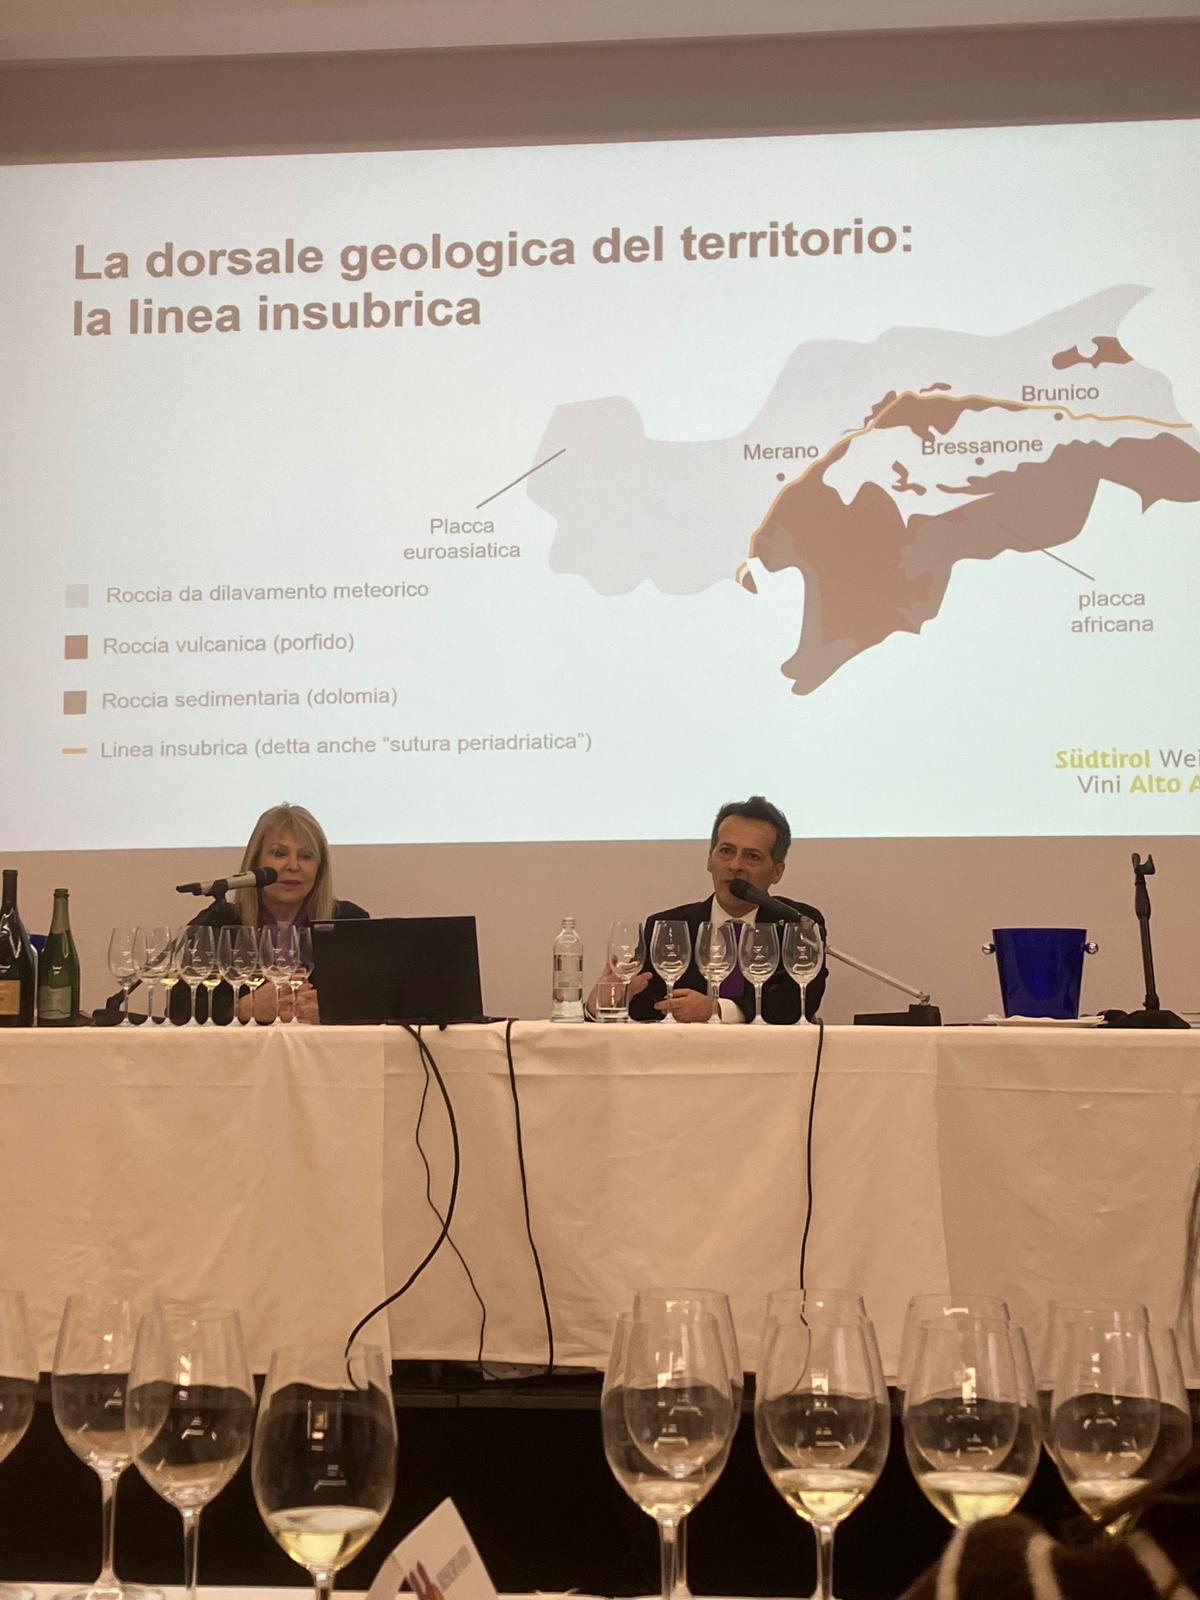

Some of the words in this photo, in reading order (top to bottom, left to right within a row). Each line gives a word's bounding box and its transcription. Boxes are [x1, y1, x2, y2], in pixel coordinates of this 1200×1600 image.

[75, 245, 128, 280] La
[146, 238, 323, 278] dorsale
[340, 231, 575, 281] geologica
[593, 226, 663, 264] del
[680, 218, 911, 261] territorio:
[74, 301, 111, 336] la
[130, 298, 240, 335] linea
[259, 291, 480, 331] insubrica
[1021, 384, 1099, 402] Brunico
[743, 444, 819, 460] Merano
[921, 437, 1043, 455] Bressanone
[431, 518, 494, 534] Placca
[403, 542, 520, 559] euroasiatica
[107, 586, 172, 603] Roccia
[179, 586, 202, 602] da
[209, 584, 326, 601] dilavamento
[333, 581, 429, 598] meteorico
[1079, 590, 1145, 611] placca
[1071, 616, 1153, 632] africana
[104, 637, 169, 654] Roccia
[176, 635, 266, 653] vulcanica
[274, 633, 354, 654] (porfido)
[102, 692, 168, 709] Roccia
[174, 690, 299, 707] sedimentaria
[307, 688, 397, 708] (dolomia)
[101, 742, 153, 758] Linea
[160, 740, 247, 757] insubrica
[255, 738, 310, 758] (detta
[317, 738, 376, 753] anche
[1056, 748, 1151, 768] Südtirol
[1077, 775, 1120, 793] Vini
[1130, 774, 1181, 793] Alto
